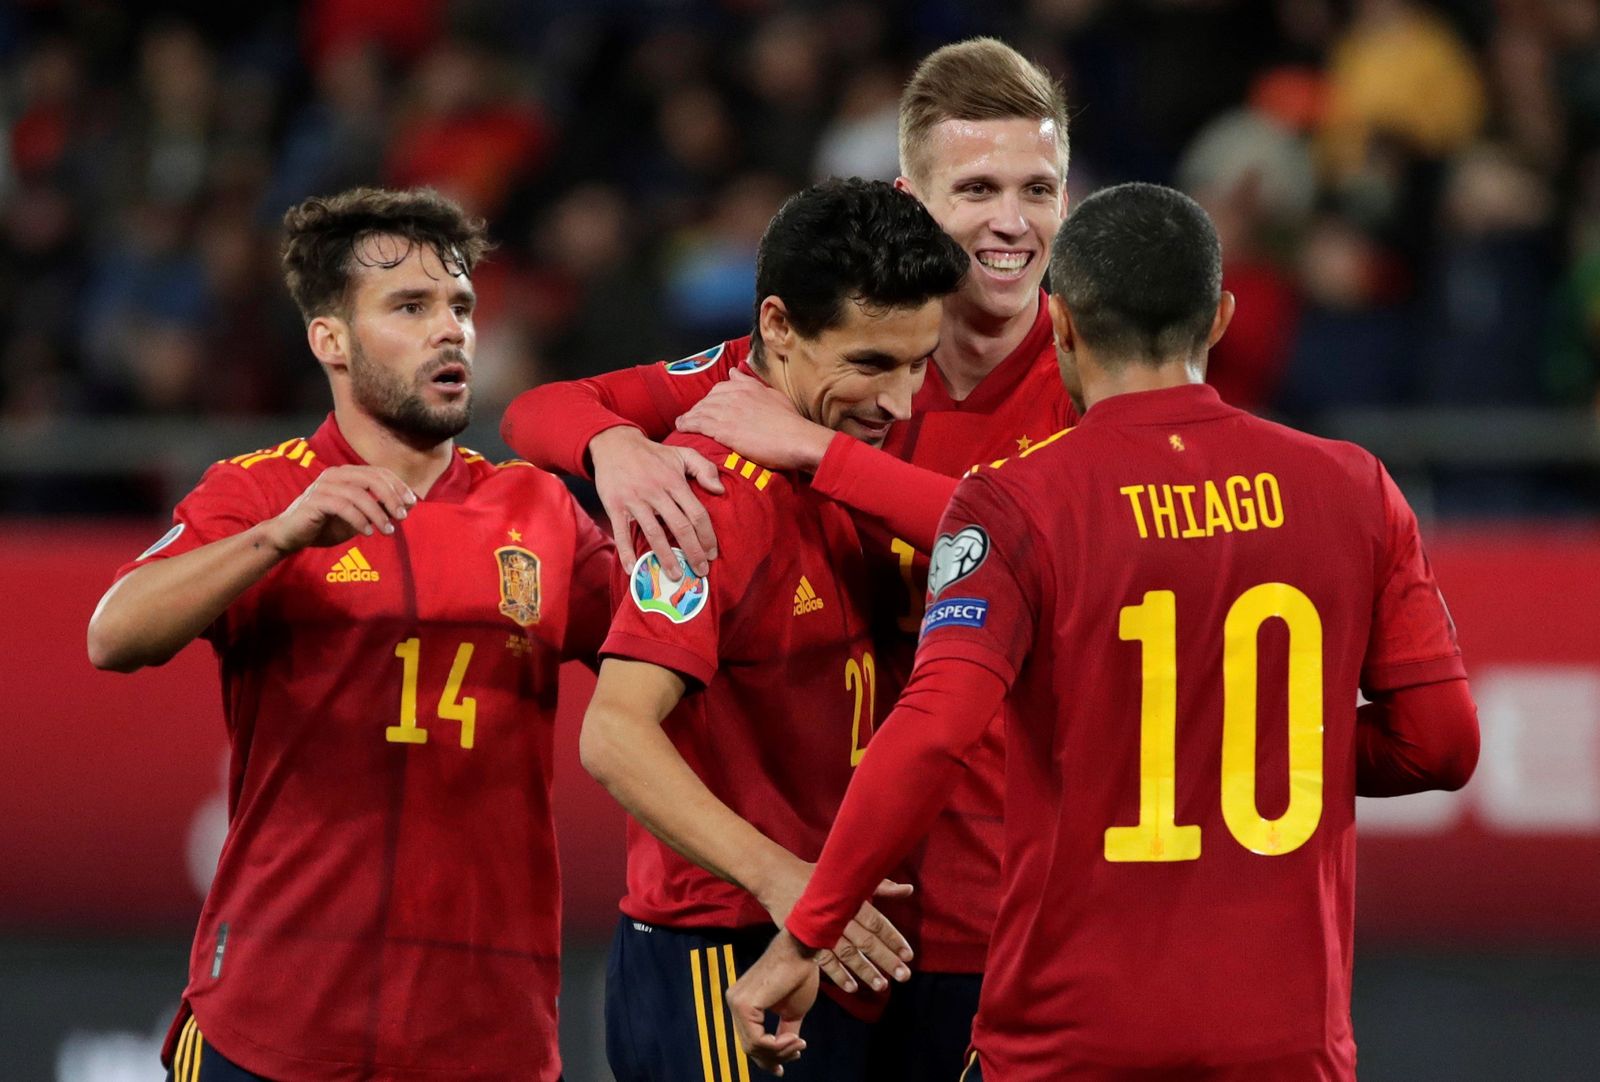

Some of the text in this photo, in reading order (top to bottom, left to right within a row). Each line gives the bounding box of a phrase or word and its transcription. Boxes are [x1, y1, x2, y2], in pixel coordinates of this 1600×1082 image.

[1120, 472, 1285, 539] THIAGO
[326, 568, 380, 583] adidas
[385, 637, 477, 749] 14
[1104, 582, 1323, 863] 10
